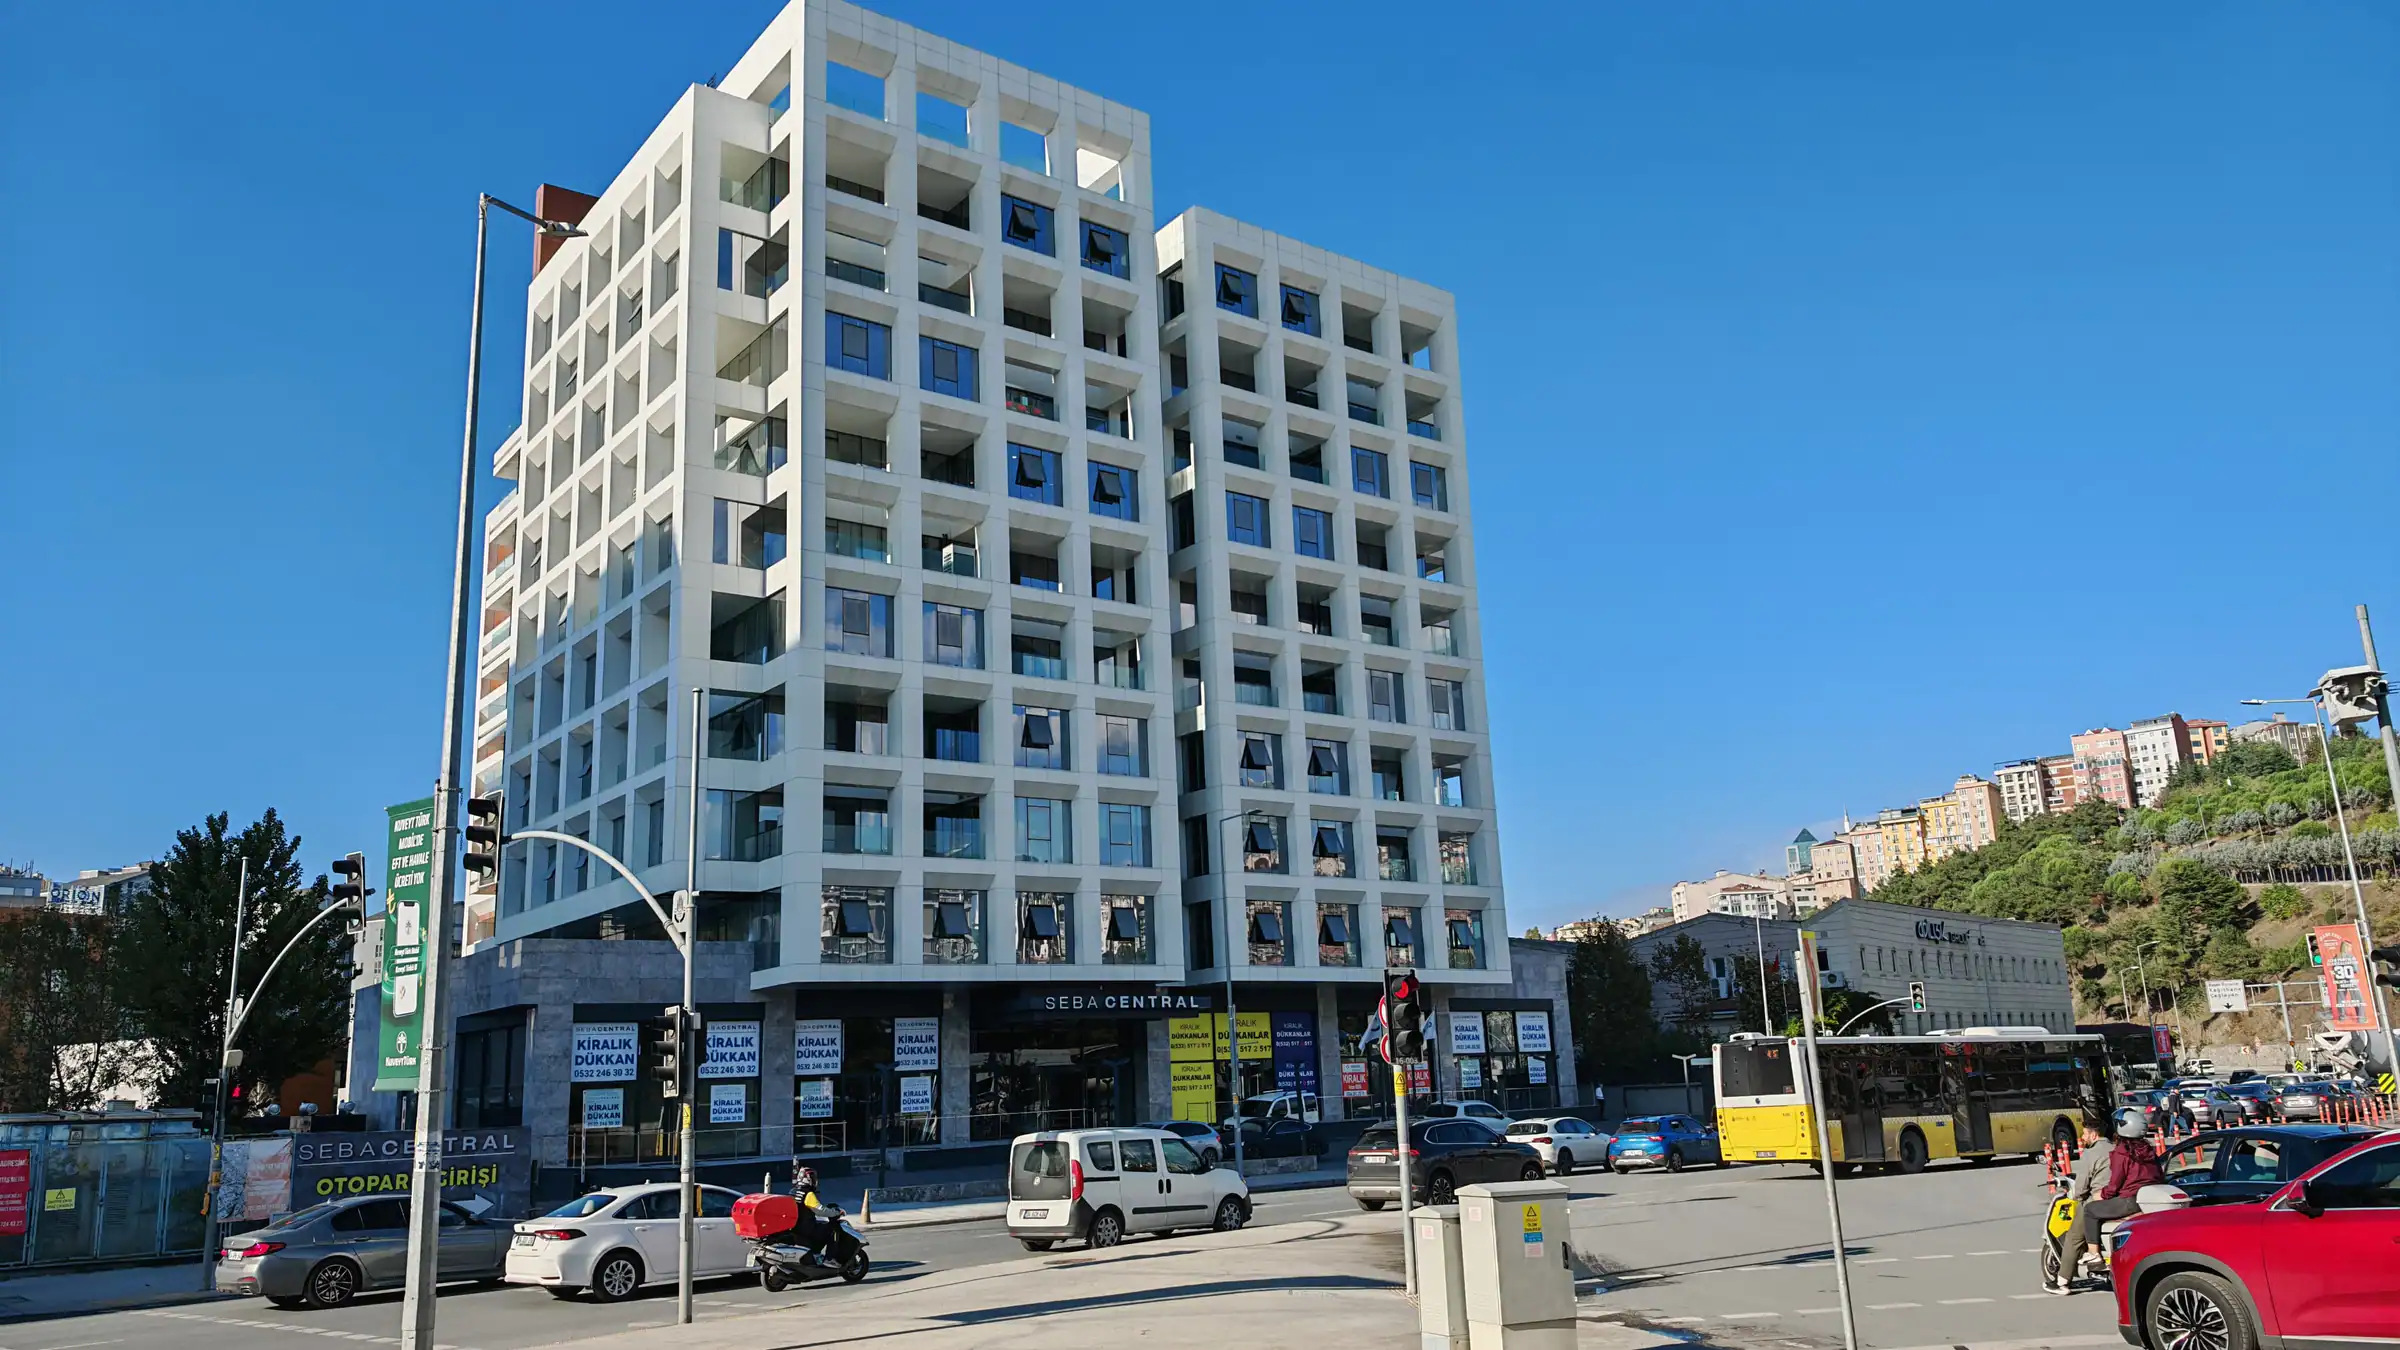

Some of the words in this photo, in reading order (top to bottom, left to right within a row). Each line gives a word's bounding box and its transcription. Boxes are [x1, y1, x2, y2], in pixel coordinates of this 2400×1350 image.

[415, 812, 430, 827] TÜRK
[392, 857, 401, 870] EFT
[402, 855, 409, 868] VE
[409, 851, 429, 866] HAVALE
[414, 872, 425, 884] YOK
[51, 888, 100, 903] ORION
[1105, 995, 1199, 1008] CENTRAL
[1237, 1019, 1257, 1027] RALIK
[798, 1036, 837, 1047] KİRALIK
[898, 1033, 935, 1044] KİRALIK
[1455, 1032, 1480, 1041] DÜKKAN
[577, 1037, 632, 1050] KİRALIK
[797, 1049, 838, 1059] DÜKKAN
[897, 1045, 936, 1055] DÜKKAN
[575, 1052, 634, 1066] DÜKKAN
[589, 1103, 619, 1111] KİRALIK
[316, 1173, 409, 1196] OTOPAR
